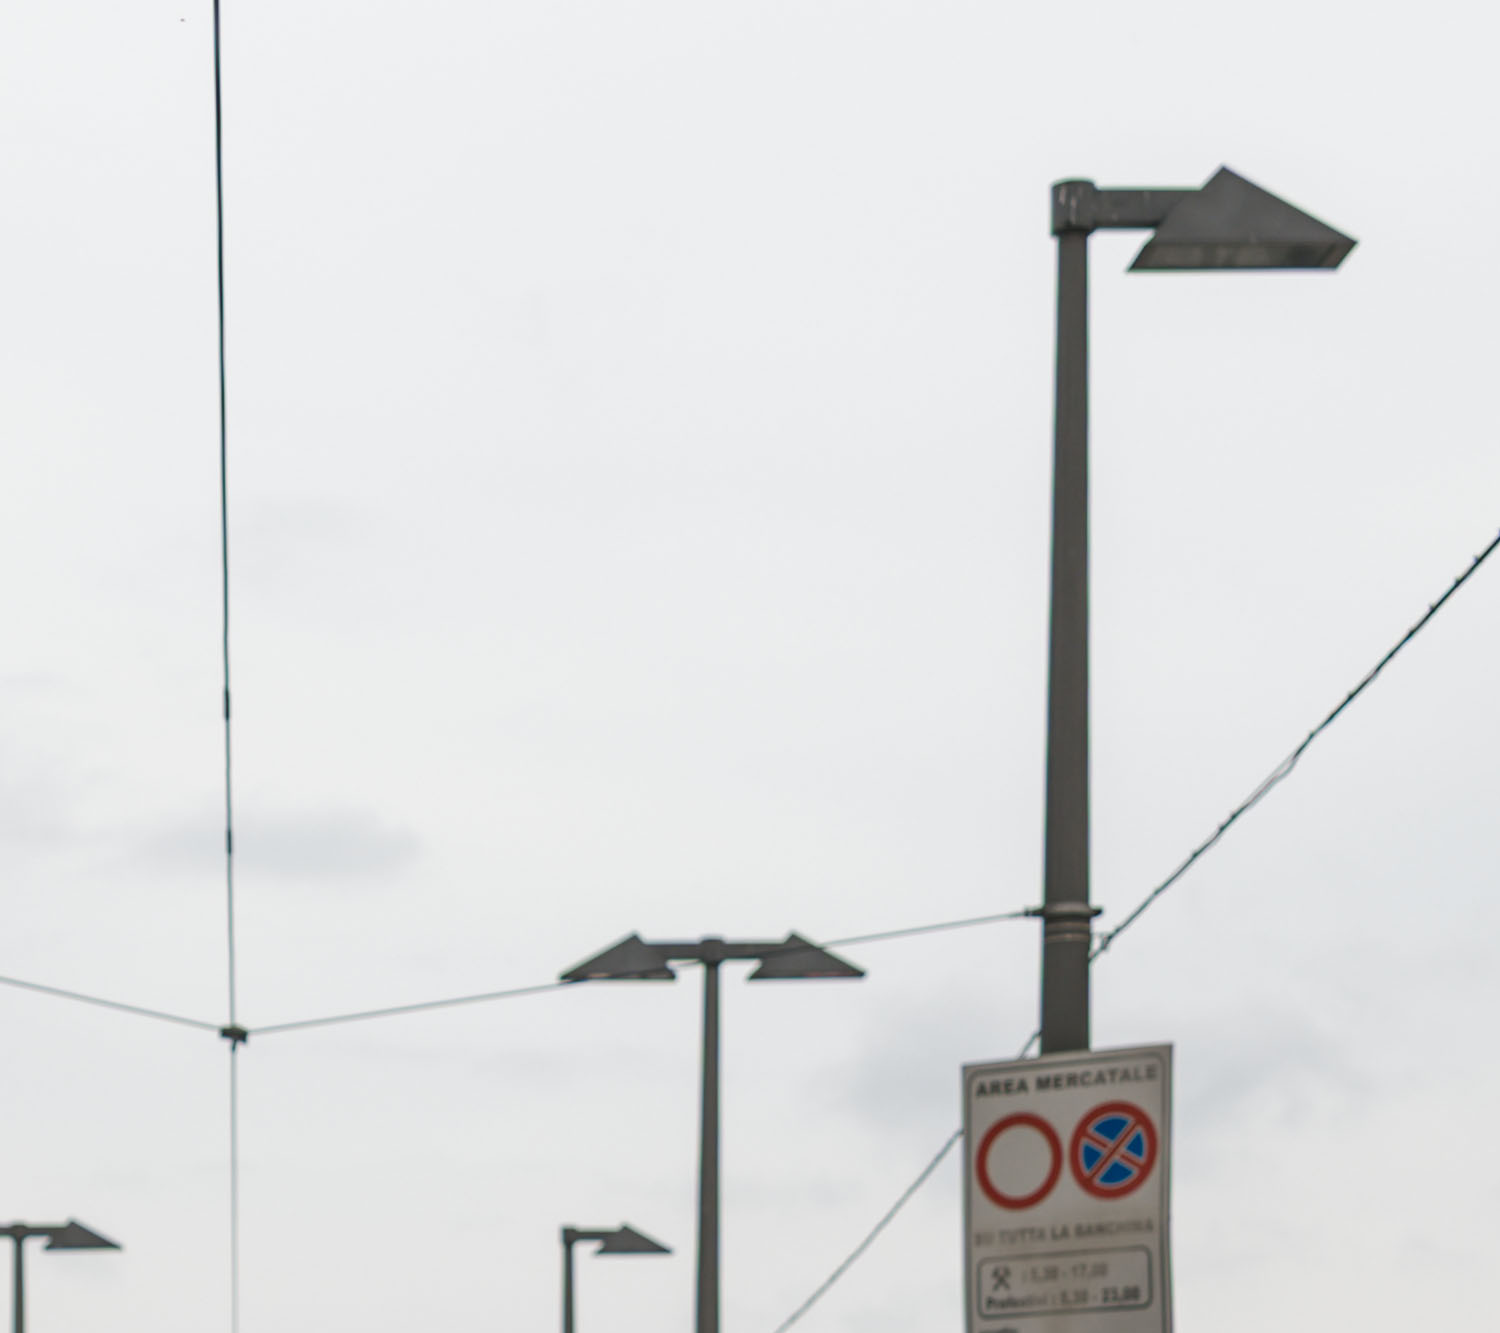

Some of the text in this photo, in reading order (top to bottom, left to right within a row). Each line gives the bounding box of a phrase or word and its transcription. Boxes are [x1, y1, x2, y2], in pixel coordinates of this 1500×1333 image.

[976, 1064, 1157, 1097] AREA MERCATALE
[1051, 1224, 1070, 1241] LA
